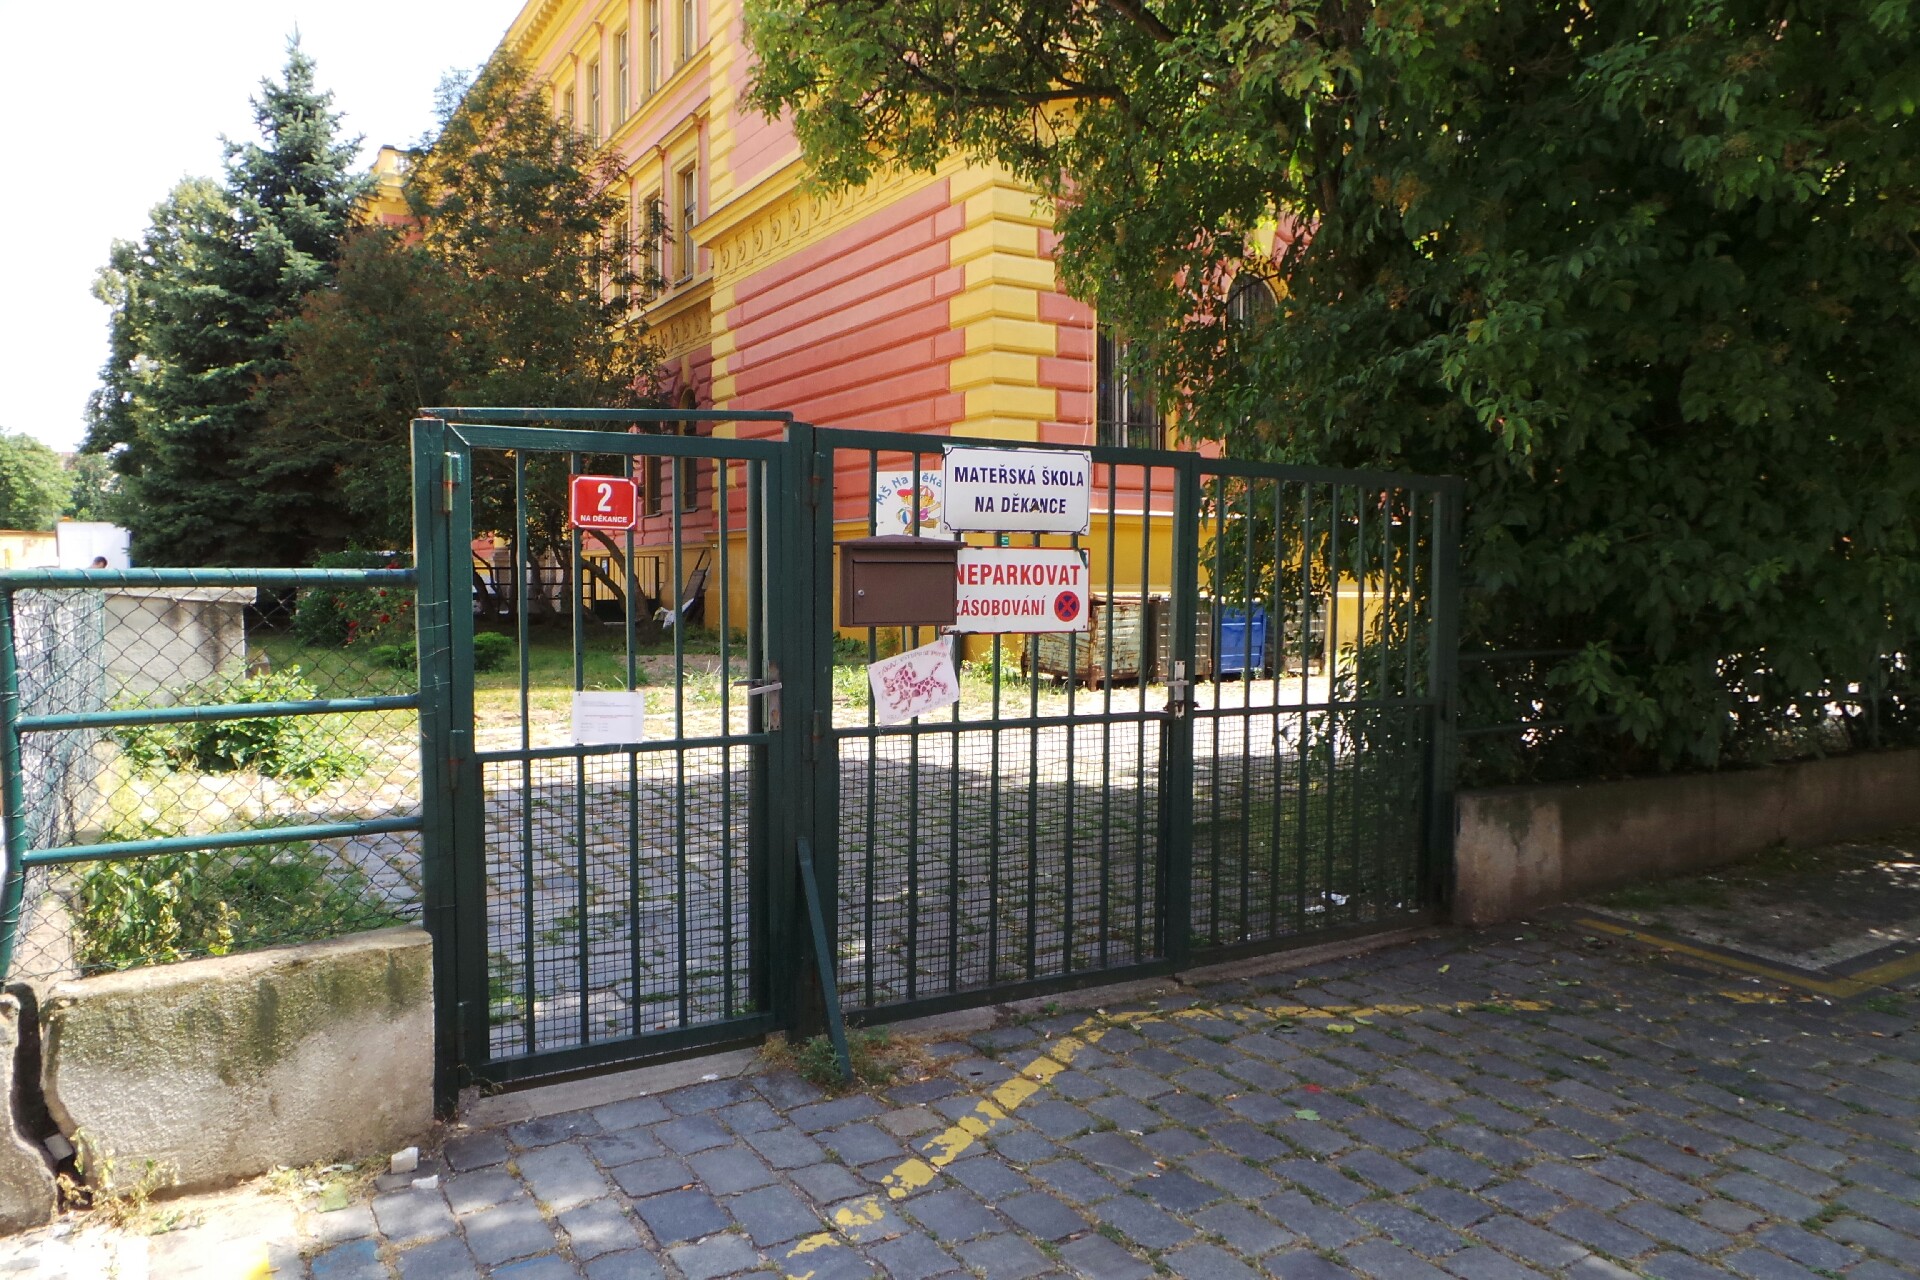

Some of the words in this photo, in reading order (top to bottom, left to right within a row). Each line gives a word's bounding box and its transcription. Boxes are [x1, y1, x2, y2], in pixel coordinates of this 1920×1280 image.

[892, 476, 908, 488] Na
[922, 472, 942, 488] ěka
[954, 464, 1036, 485] MATEŘSKÁ
[1042, 466, 1084, 487] ŠKOLA
[598, 483, 612, 512] 2
[974, 496, 994, 513] NA
[1001, 493, 1066, 514] DĚKANCE
[592, 514, 628, 522] DĚKANCE
[957, 564, 1080, 586] NEPARKOVAT
